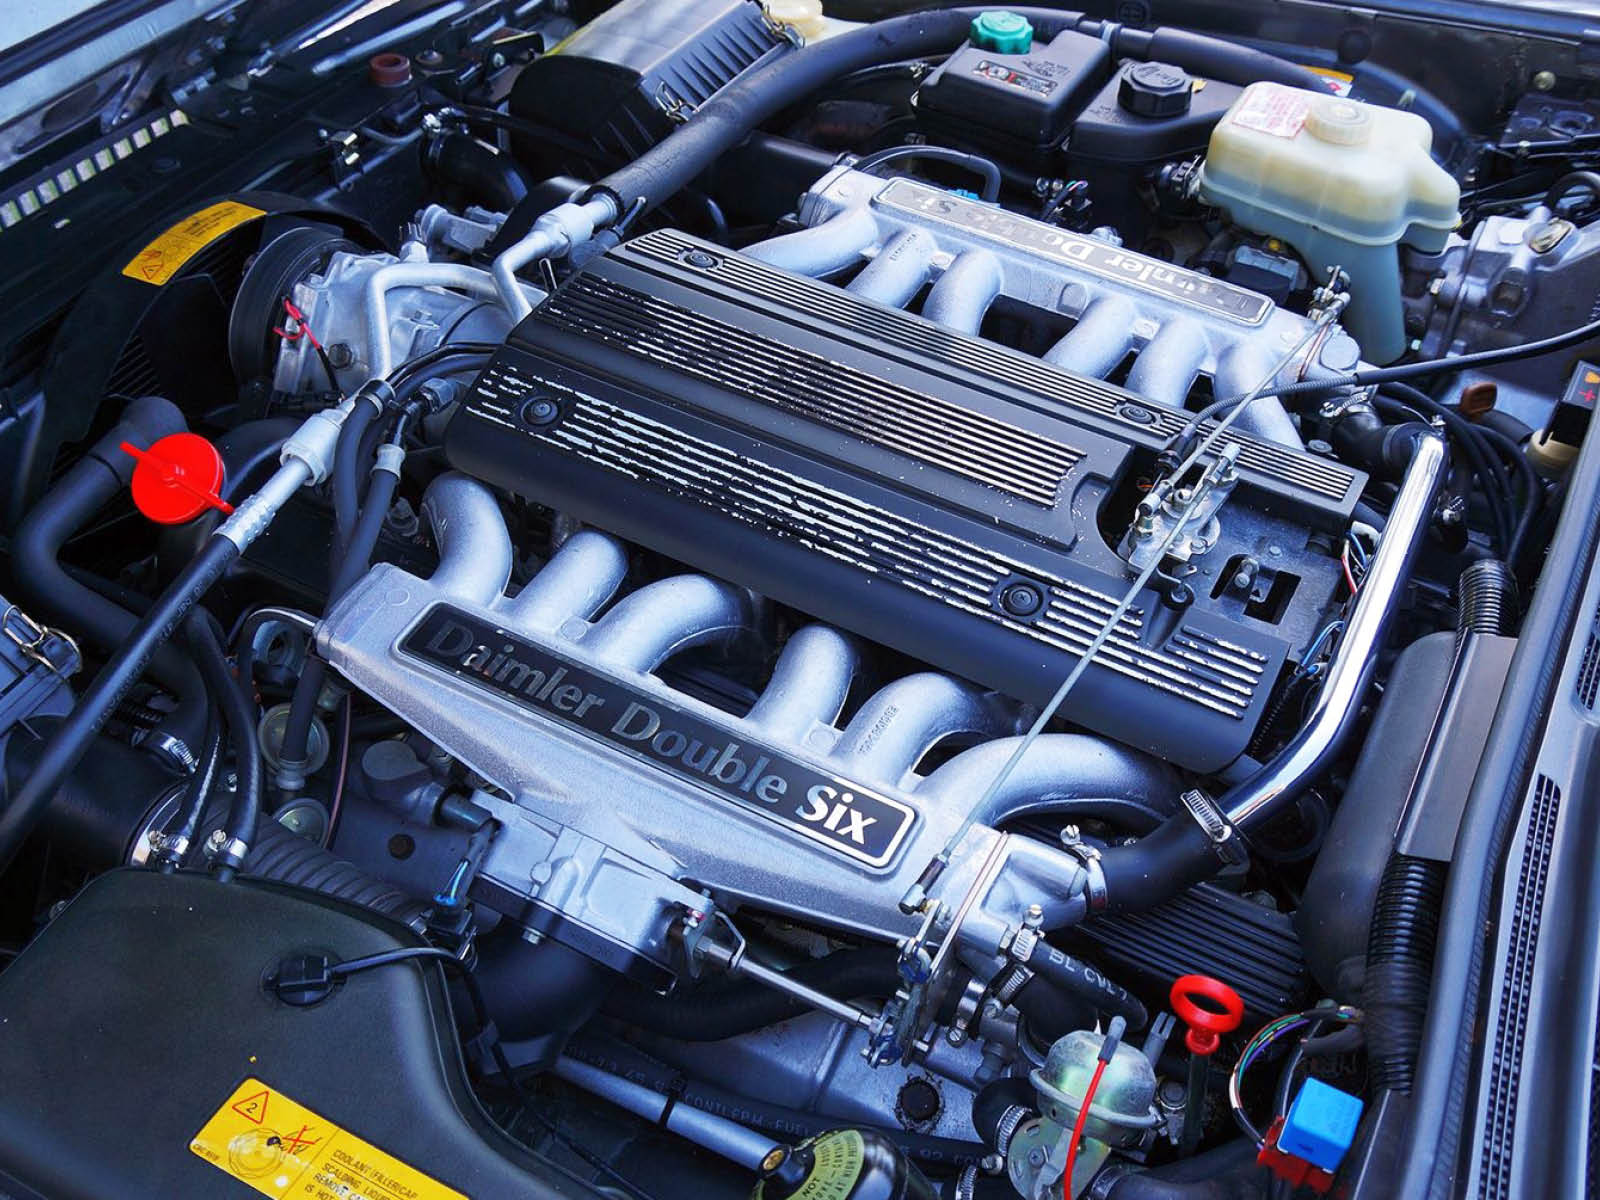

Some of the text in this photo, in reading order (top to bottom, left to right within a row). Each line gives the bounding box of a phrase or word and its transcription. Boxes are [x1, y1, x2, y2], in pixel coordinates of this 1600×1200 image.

[426, 618, 606, 720] Daimler
[612, 701, 789, 804] Double
[795, 784, 880, 845] Six
[246, 1102, 258, 1114] 2
[333, 1149, 372, 1174] COOLANT
[322, 1163, 362, 1189] SCALDING
[802, 1176, 820, 1198] NOT
